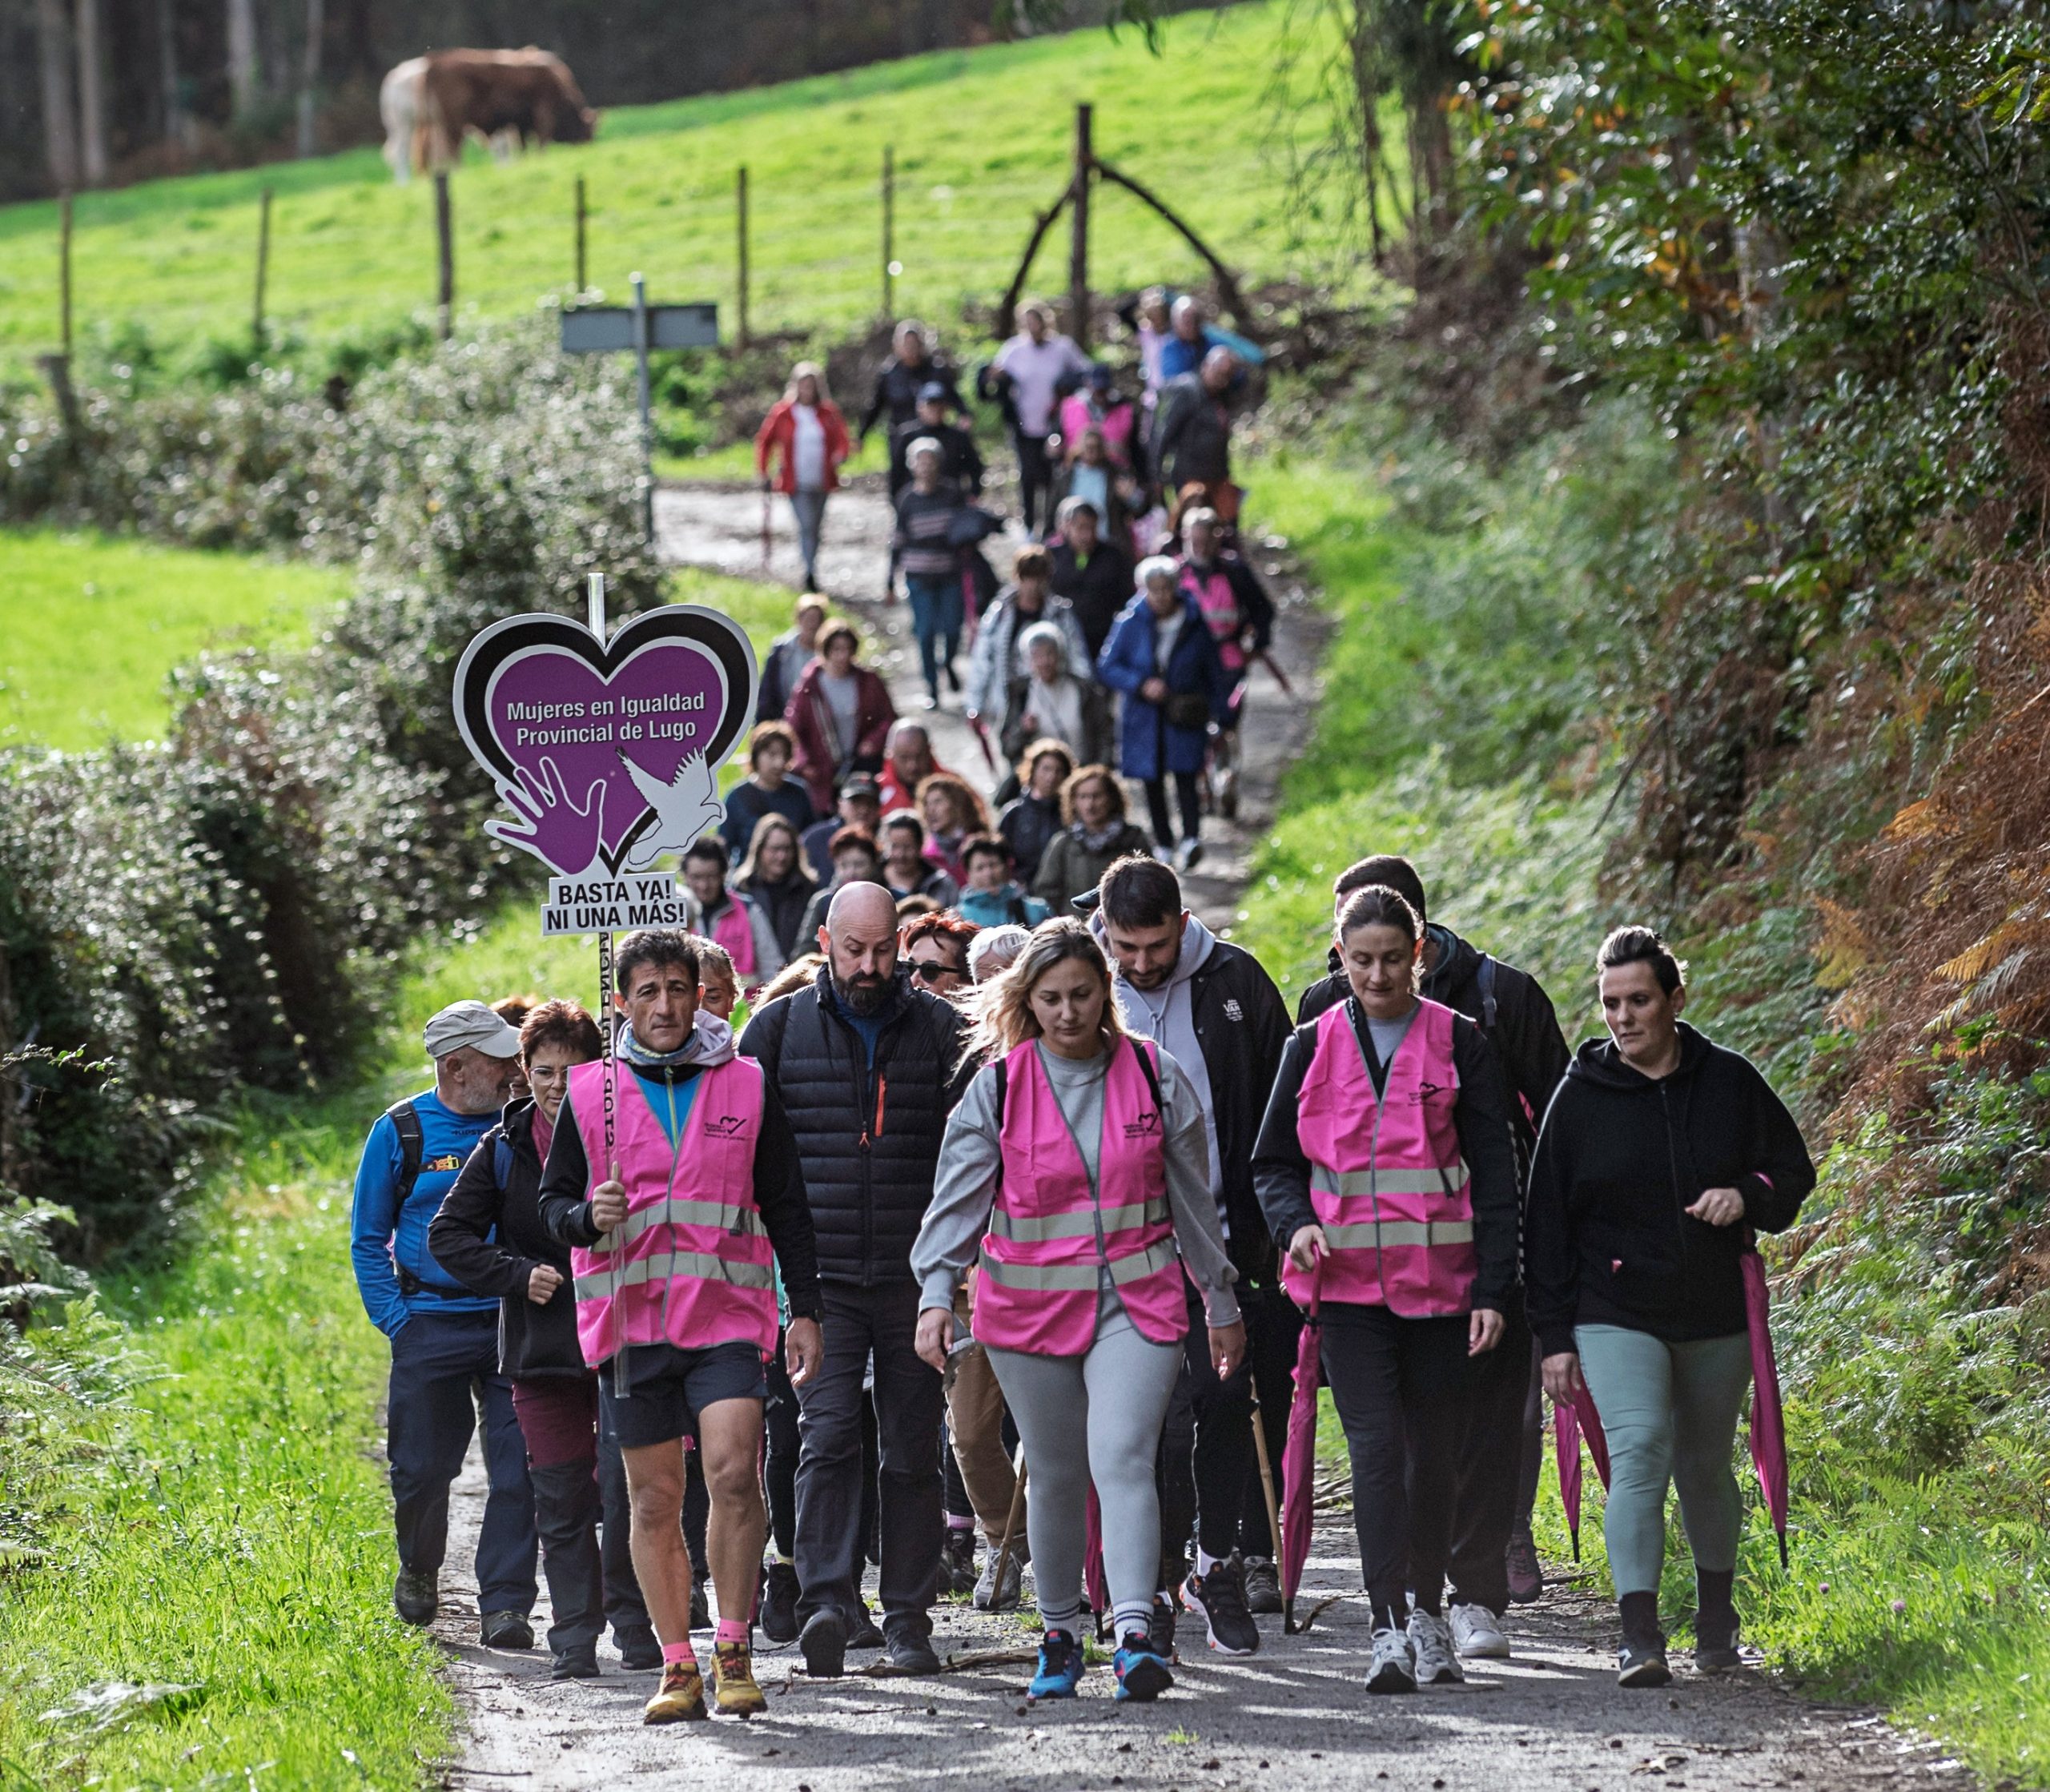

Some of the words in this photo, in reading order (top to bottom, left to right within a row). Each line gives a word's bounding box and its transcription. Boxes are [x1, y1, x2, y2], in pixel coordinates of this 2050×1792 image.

[507, 701, 585, 724] Mujeres
[591, 701, 614, 716] en
[621, 692, 705, 717] Igualdad
[517, 723, 613, 746] Provincial
[619, 722, 643, 741] de
[649, 720, 697, 741] Lugo
[558, 882, 630, 906] BASTA
[635, 879, 670, 901] YA!
[547, 910, 569, 930] NI
[576, 906, 621, 928] UNA
[629, 899, 684, 926] MÁS!
